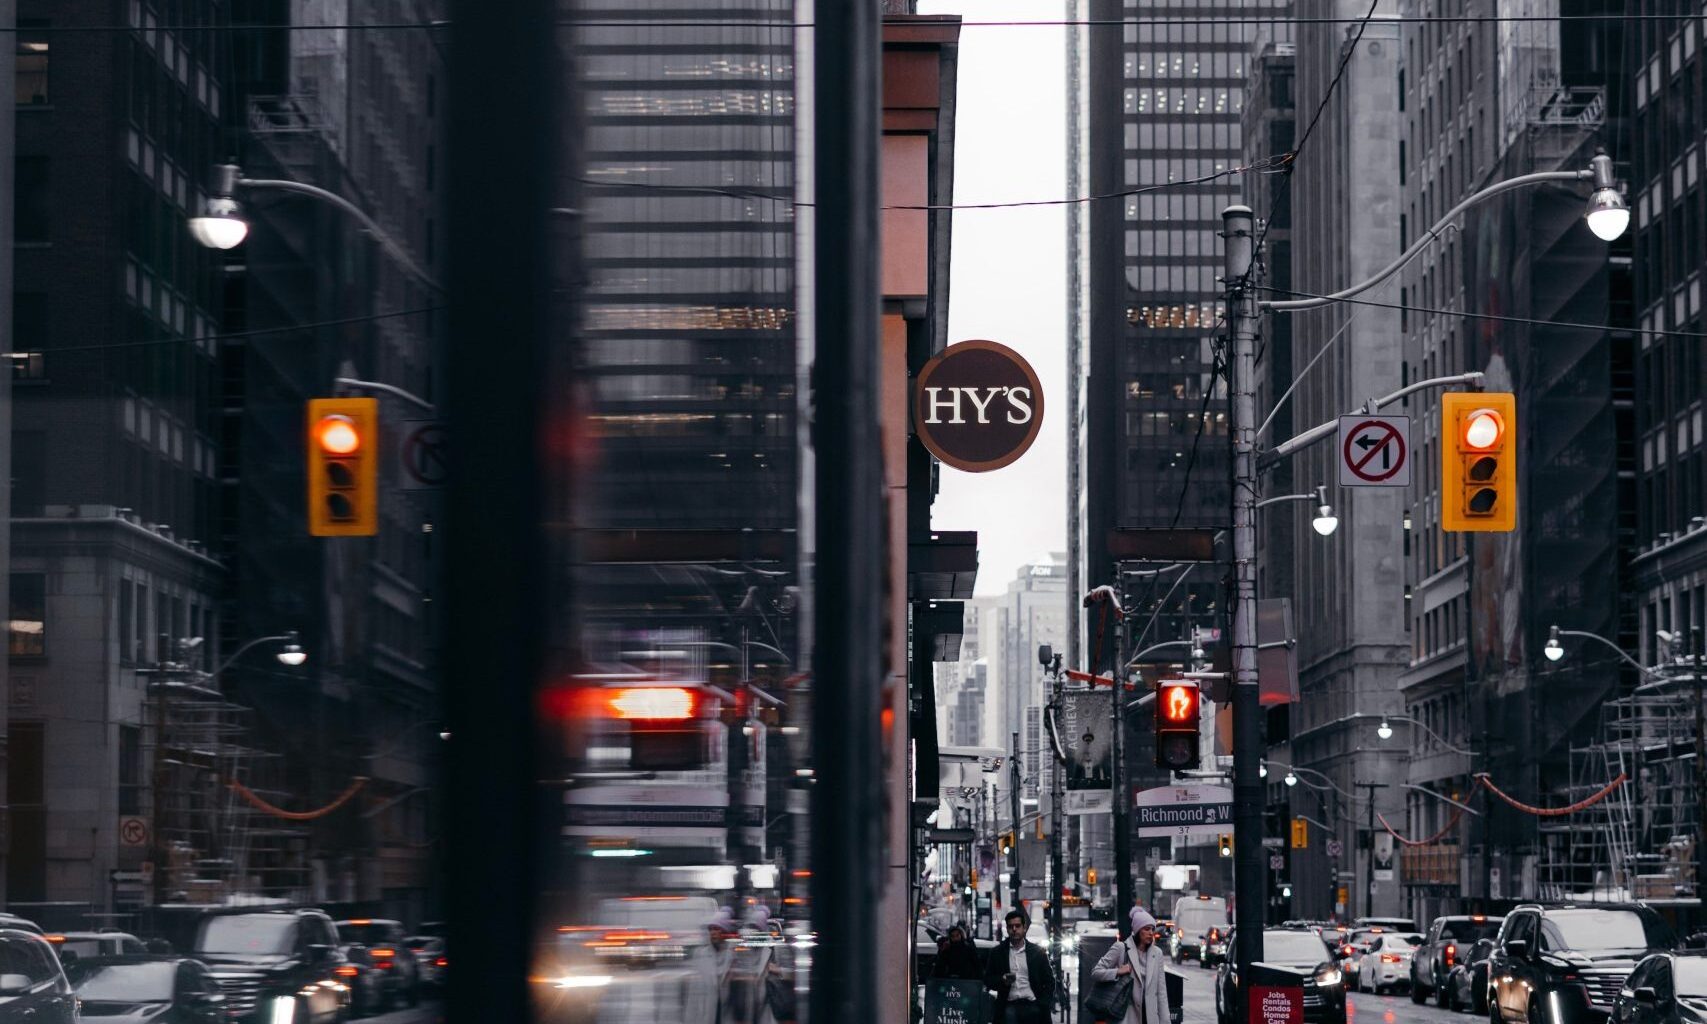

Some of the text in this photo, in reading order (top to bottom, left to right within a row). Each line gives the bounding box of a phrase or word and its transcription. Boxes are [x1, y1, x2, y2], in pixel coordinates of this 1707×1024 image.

[924, 386, 1032, 424] HY'S
[1065, 695, 1078, 749] ACHIEVE
[1141, 805, 1230, 822] Richmond W
[1178, 826, 1190, 835] 37
[1267, 991, 1286, 999] Jobs
[942, 1007, 964, 1016] Live
[1263, 1011, 1290, 1019] Homes
[936, 1015, 969, 1024] Music
